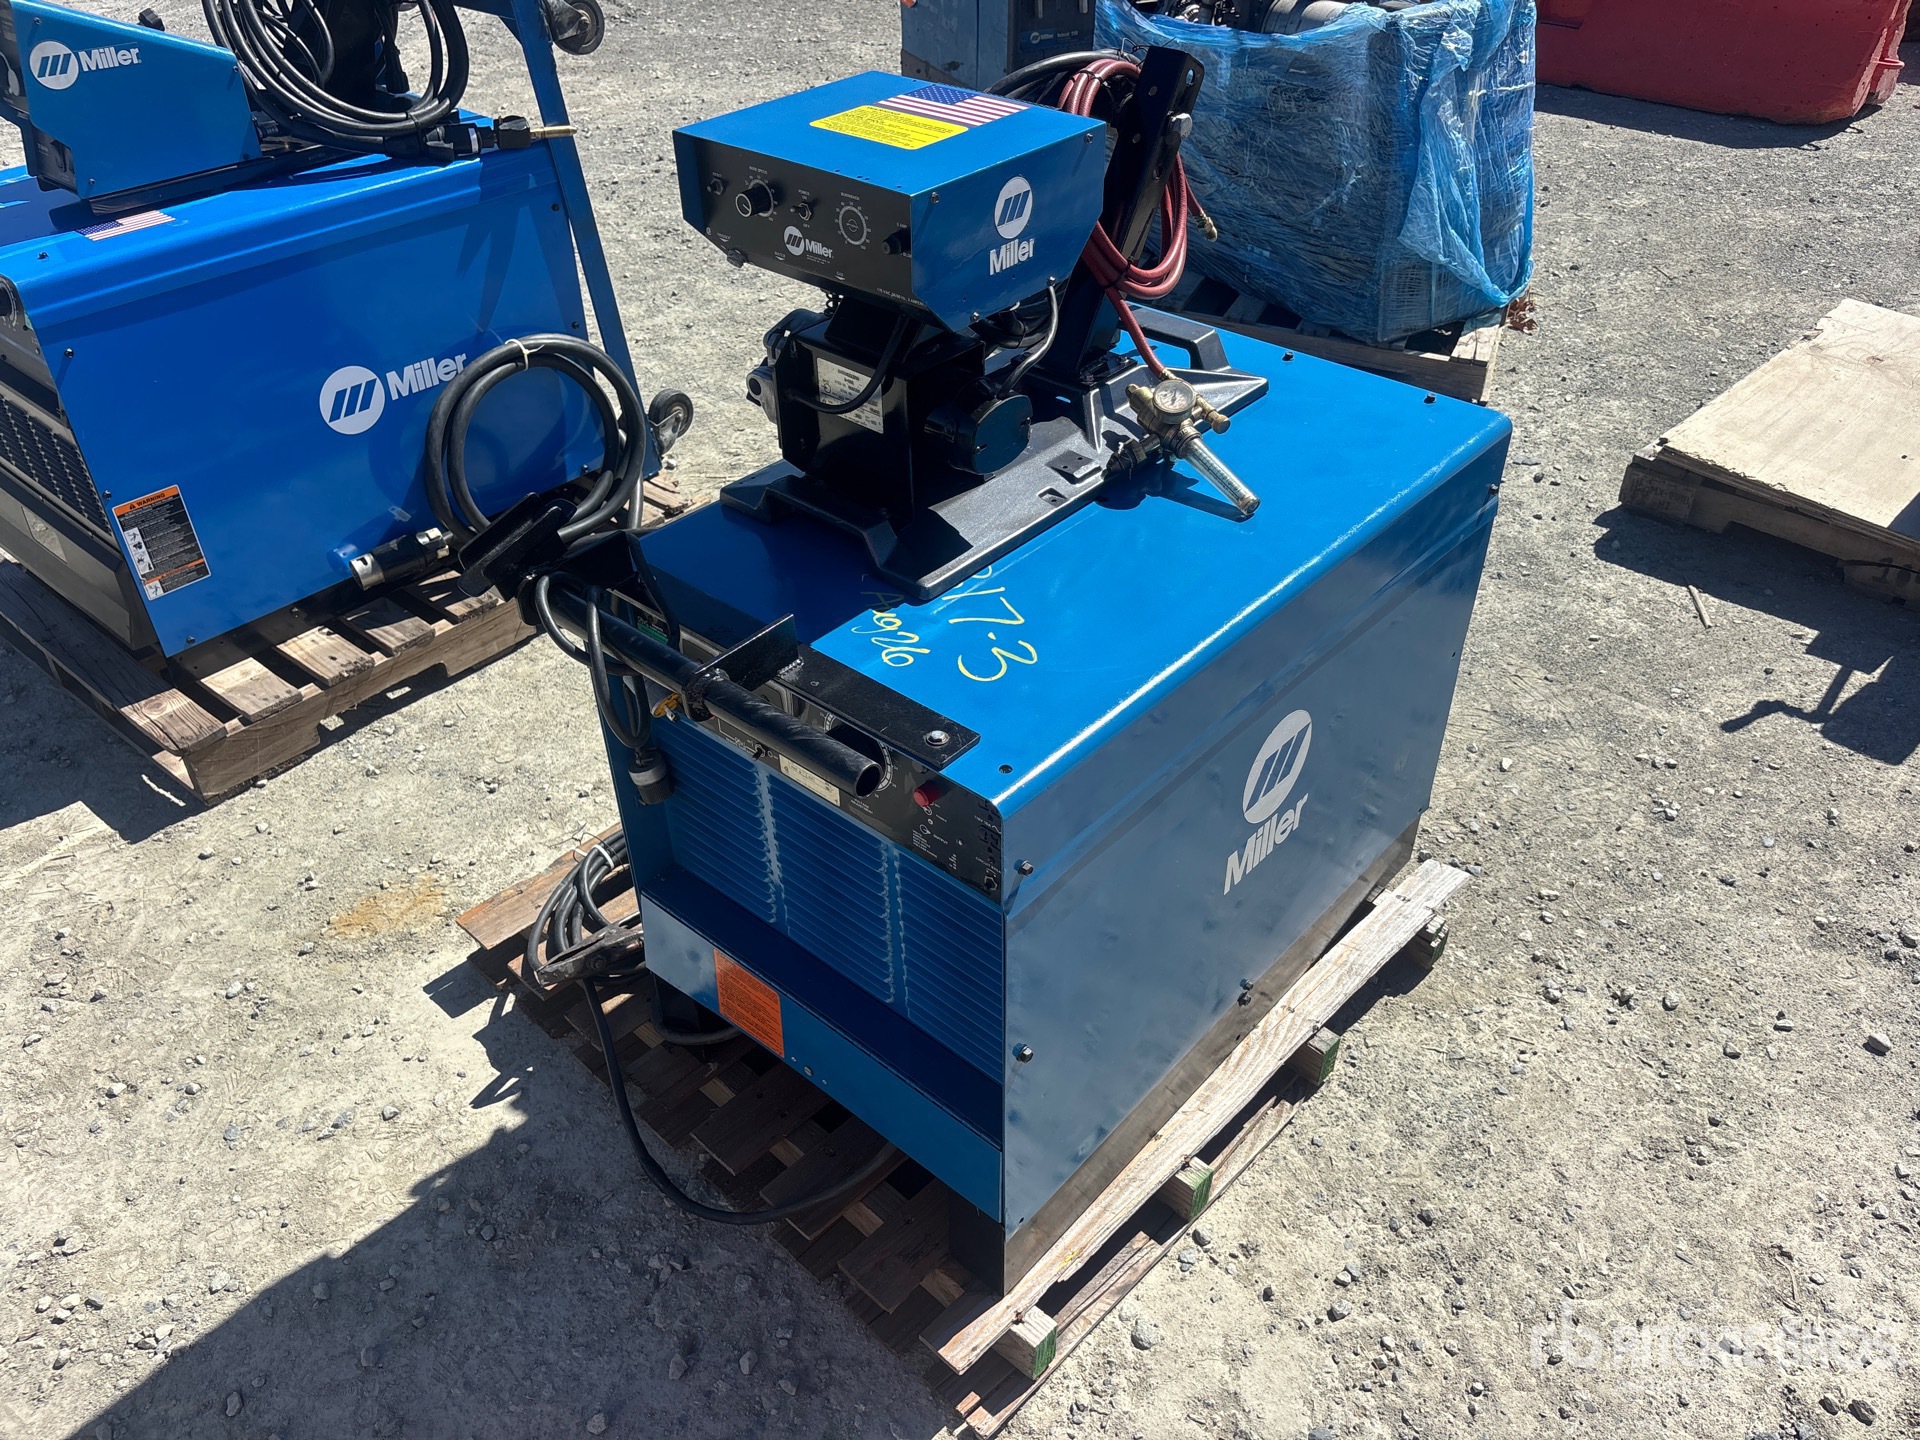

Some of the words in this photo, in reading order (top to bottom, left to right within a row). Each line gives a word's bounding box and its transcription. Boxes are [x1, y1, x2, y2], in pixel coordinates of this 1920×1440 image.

[79, 46, 140, 72] Miller
[805, 238, 834, 259] Miller
[989, 238, 1035, 276] Miller
[386, 353, 468, 401] Miller
[136, 493, 166, 507] WARNING
[1223, 792, 1309, 896] Miller
